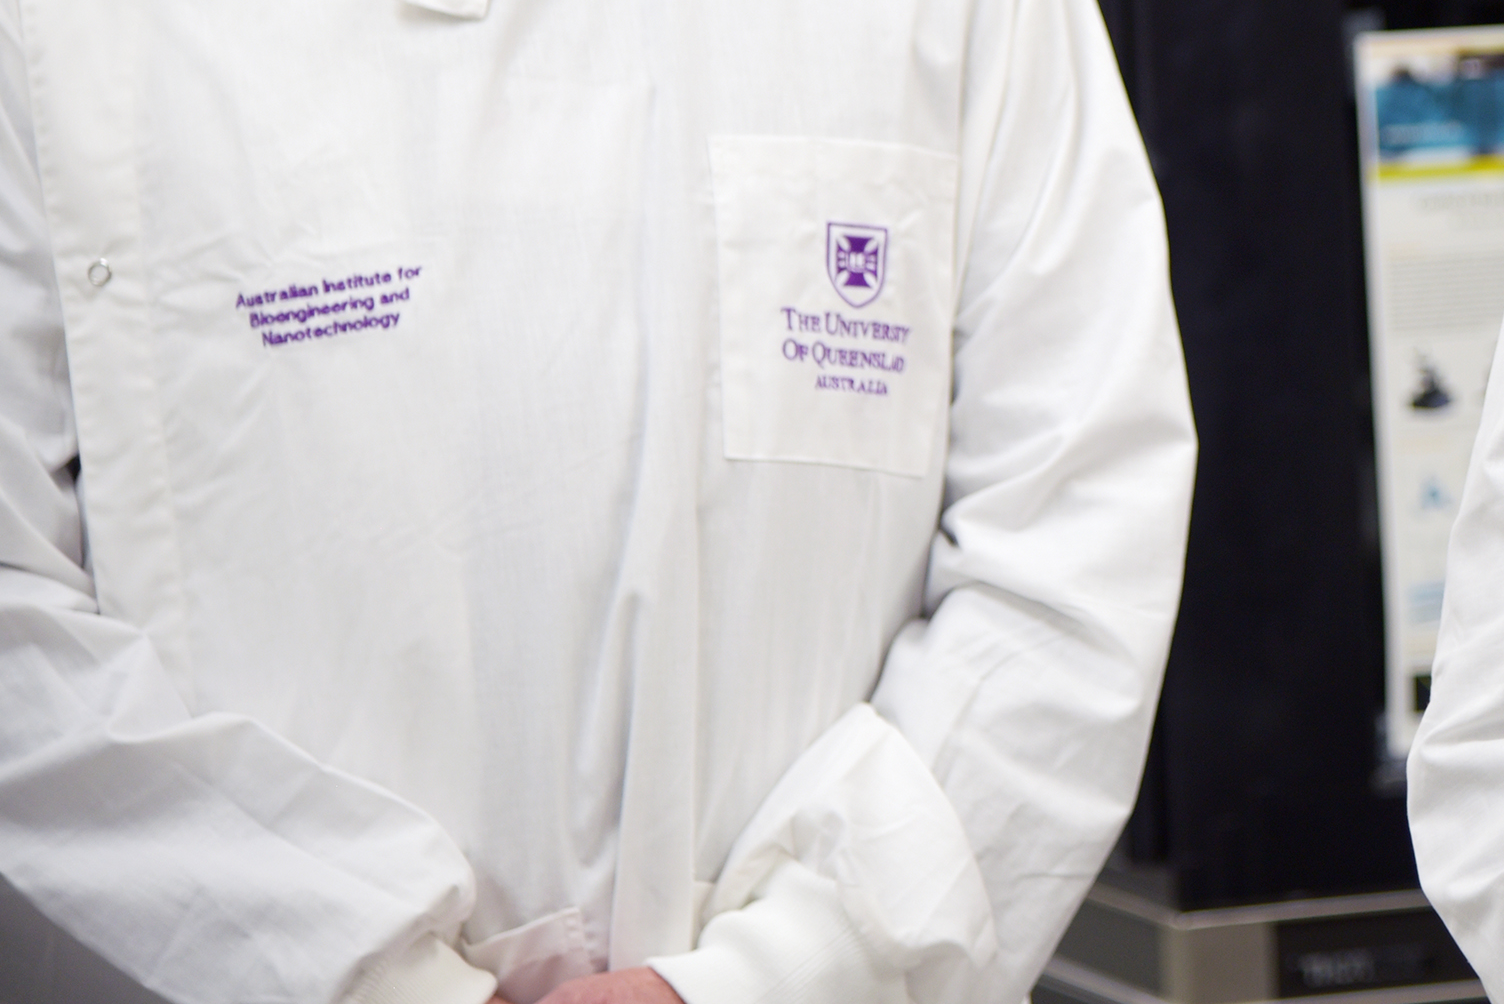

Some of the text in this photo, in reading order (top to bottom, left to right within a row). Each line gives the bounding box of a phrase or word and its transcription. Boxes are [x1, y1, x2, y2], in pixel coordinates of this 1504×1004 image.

[235, 266, 423, 308] Australian Institute for
[249, 287, 411, 329] Bioengineering and
[261, 313, 400, 346] Nanotechnology
[812, 341, 905, 372] QUEENSLD
